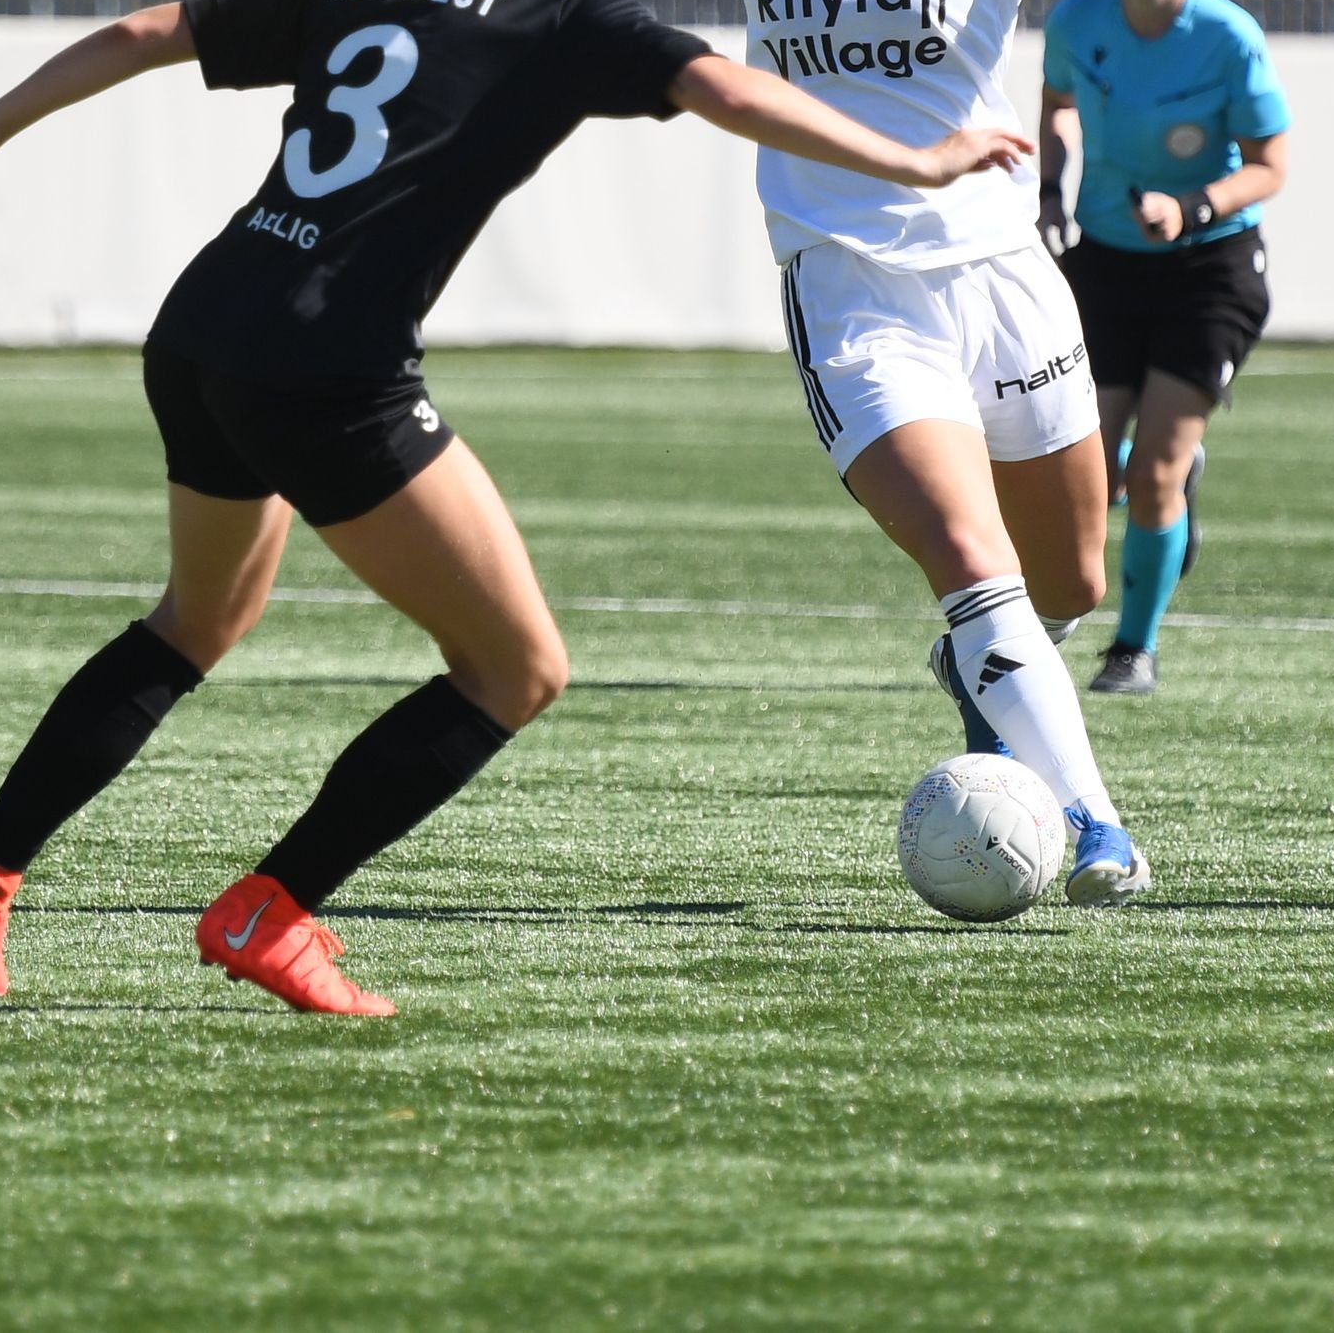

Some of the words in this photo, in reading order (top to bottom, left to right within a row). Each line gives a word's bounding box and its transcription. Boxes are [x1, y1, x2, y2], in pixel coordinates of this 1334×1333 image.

[762, 34, 947, 82] Village
[283, 23, 419, 199] 3
[994, 342, 1087, 400] halte
[412, 399, 440, 433] 3
[996, 847, 1029, 880] macron
